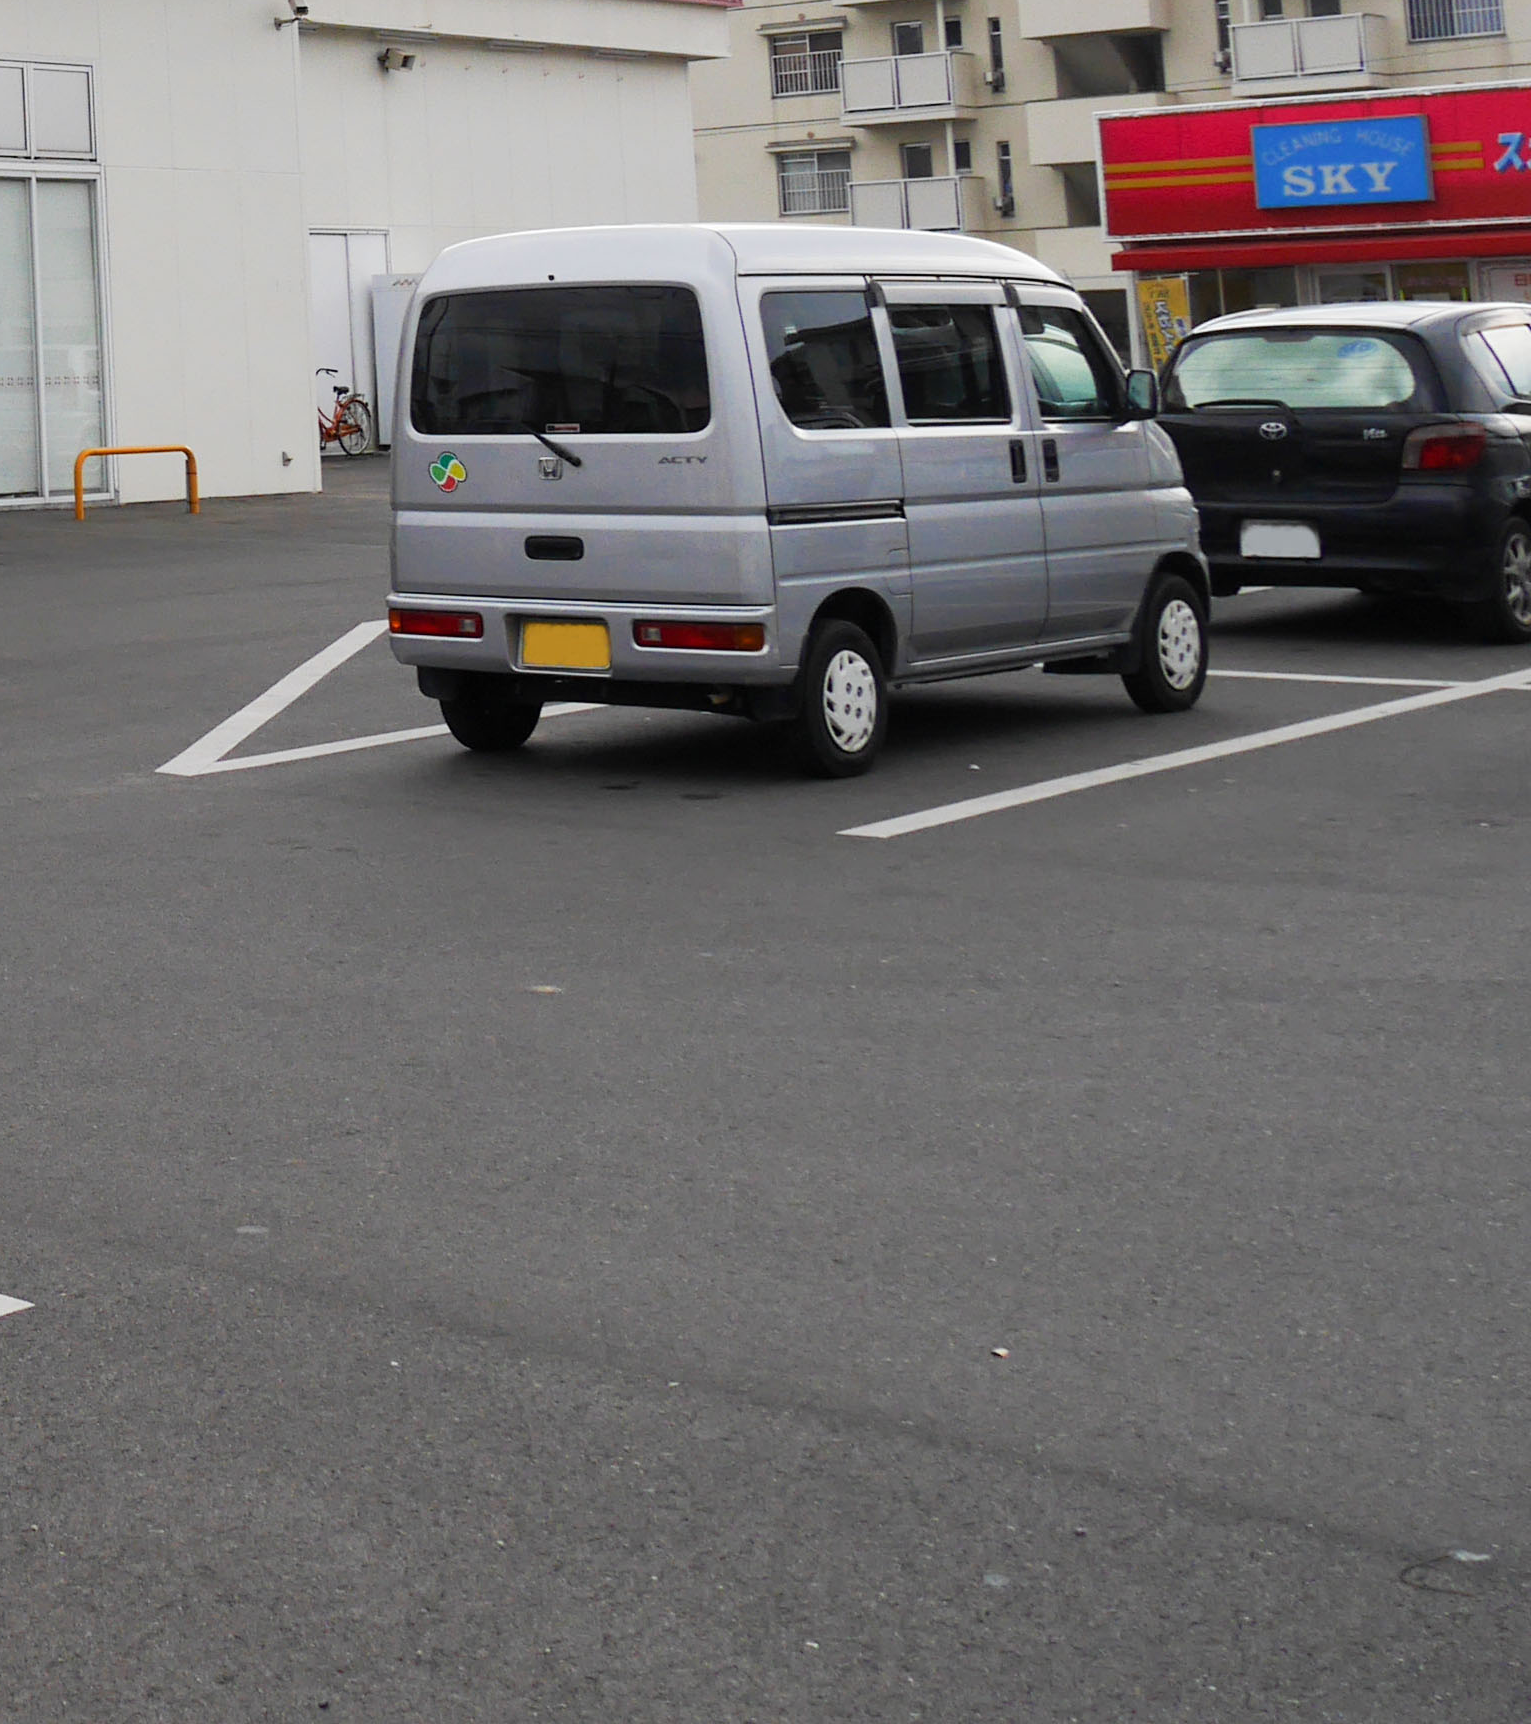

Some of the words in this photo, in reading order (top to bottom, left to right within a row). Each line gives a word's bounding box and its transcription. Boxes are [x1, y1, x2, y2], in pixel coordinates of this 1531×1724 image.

[1262, 128, 1342, 167] CLEANING
[1355, 128, 1416, 157] HOUSE
[1494, 132, 1531, 173] ス
[1282, 161, 1398, 197] SKY
[658, 456, 708, 464] ACTY
